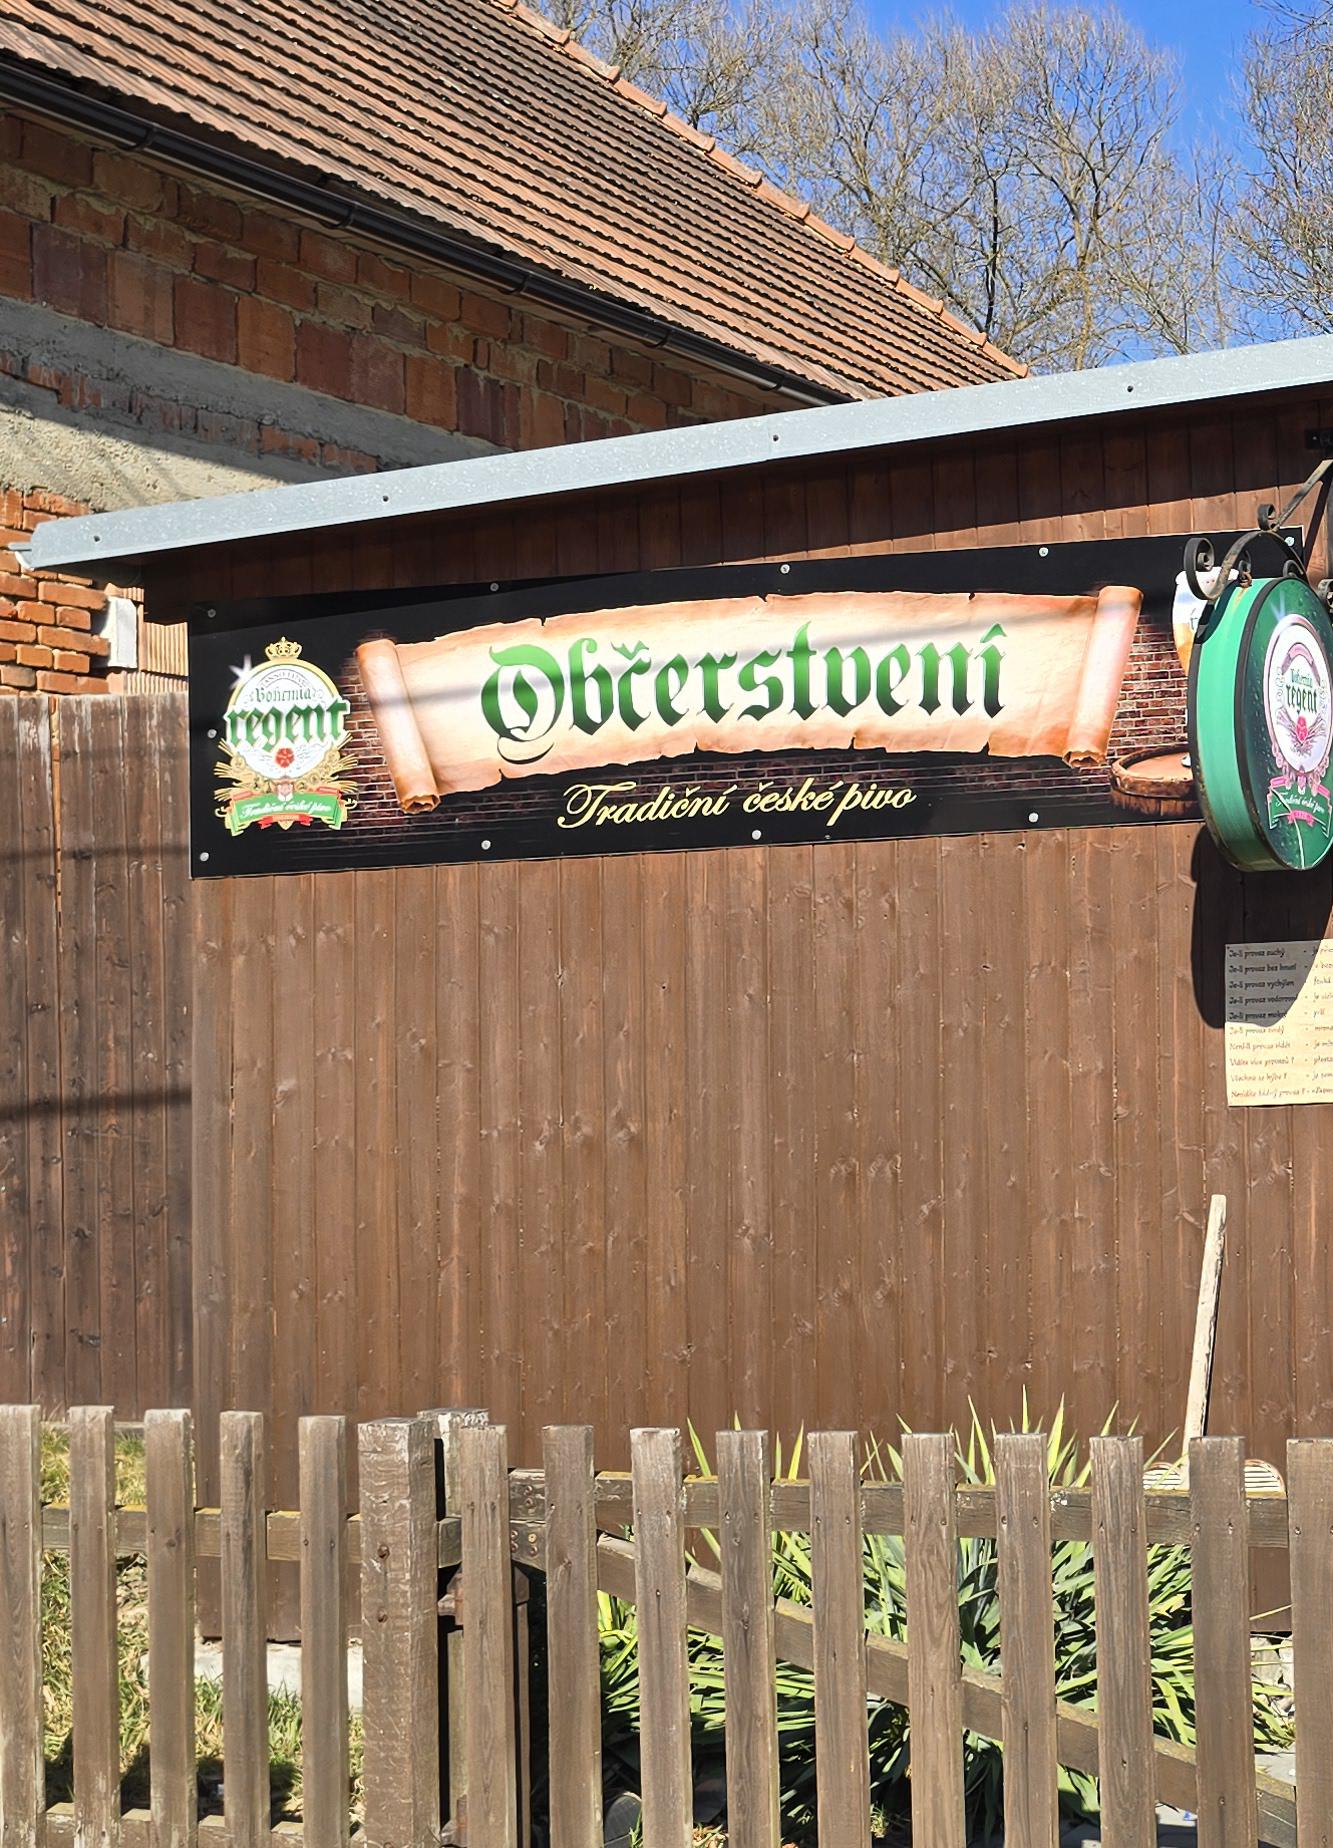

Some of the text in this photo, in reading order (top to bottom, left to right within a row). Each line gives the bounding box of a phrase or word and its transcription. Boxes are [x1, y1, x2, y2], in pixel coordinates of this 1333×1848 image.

[480, 620, 1007, 765] Občerstvení
[1285, 684, 1318, 715] regent
[227, 697, 349, 752] regent
[556, 777, 917, 829] Tradiční české pivo
